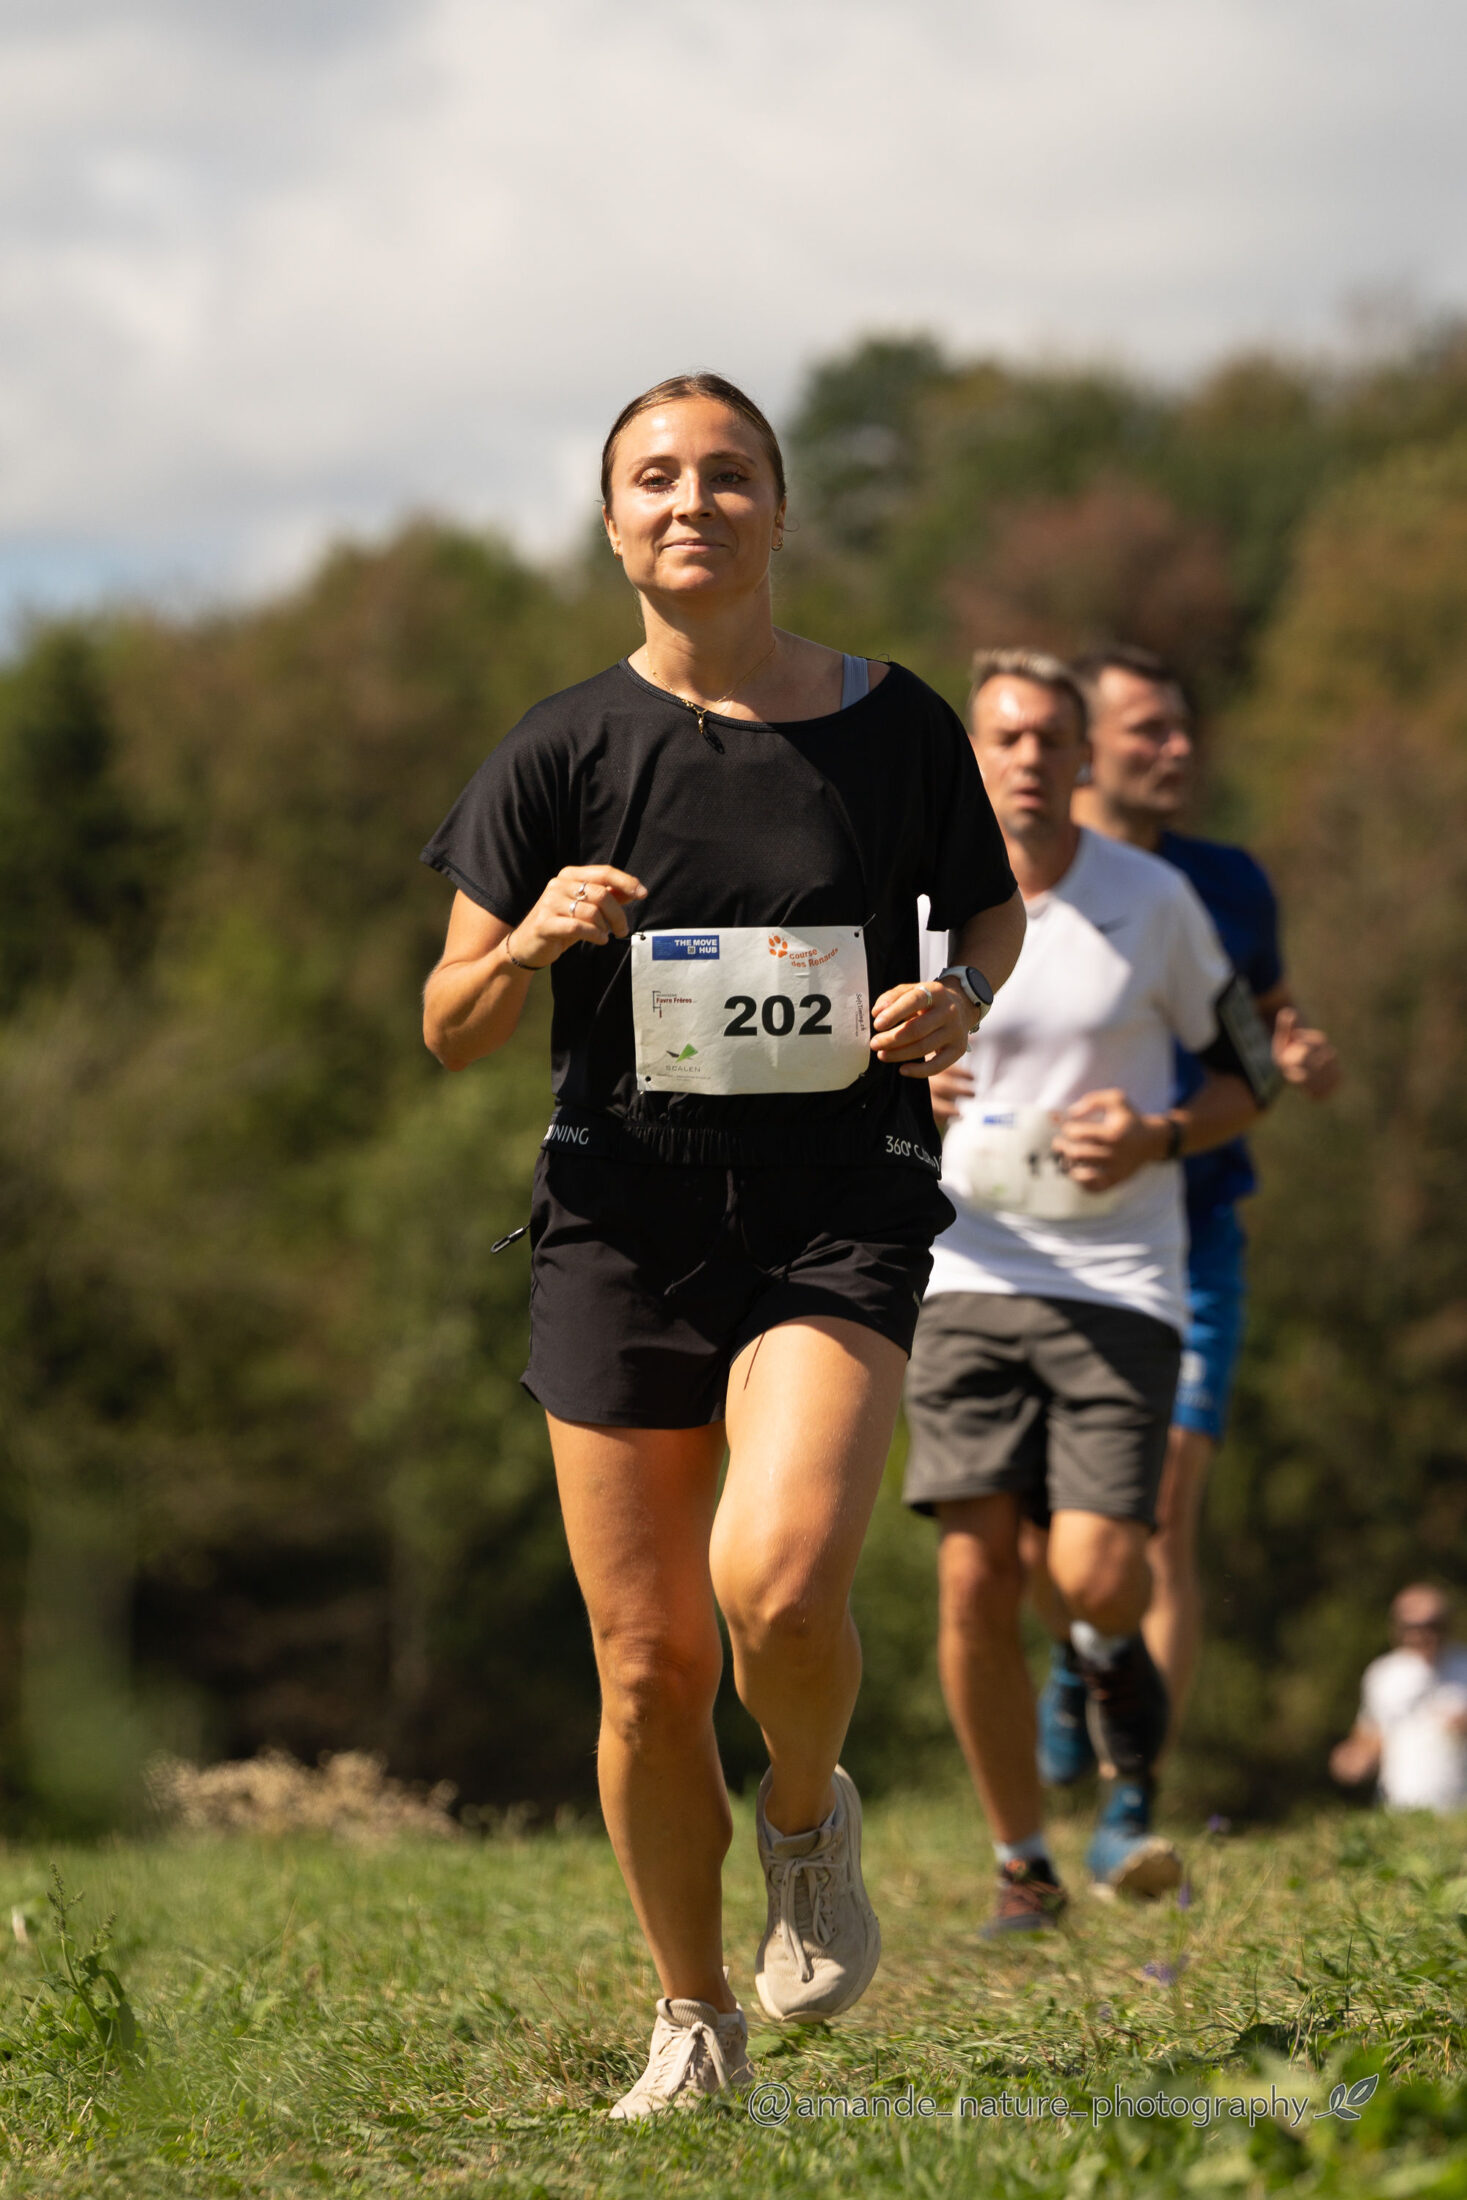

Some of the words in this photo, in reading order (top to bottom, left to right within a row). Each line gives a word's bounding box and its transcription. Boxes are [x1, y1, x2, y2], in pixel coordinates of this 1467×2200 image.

[674, 939, 692, 947] THE
[693, 939, 717, 947] MOVE
[698, 946, 718, 954] HUB
[791, 960, 807, 968] des
[807, 947, 839, 968] Renards
[723, 993, 833, 1037] 202
[665, 1065, 701, 1073] SCALEN
[545, 1124, 590, 1146] NING
